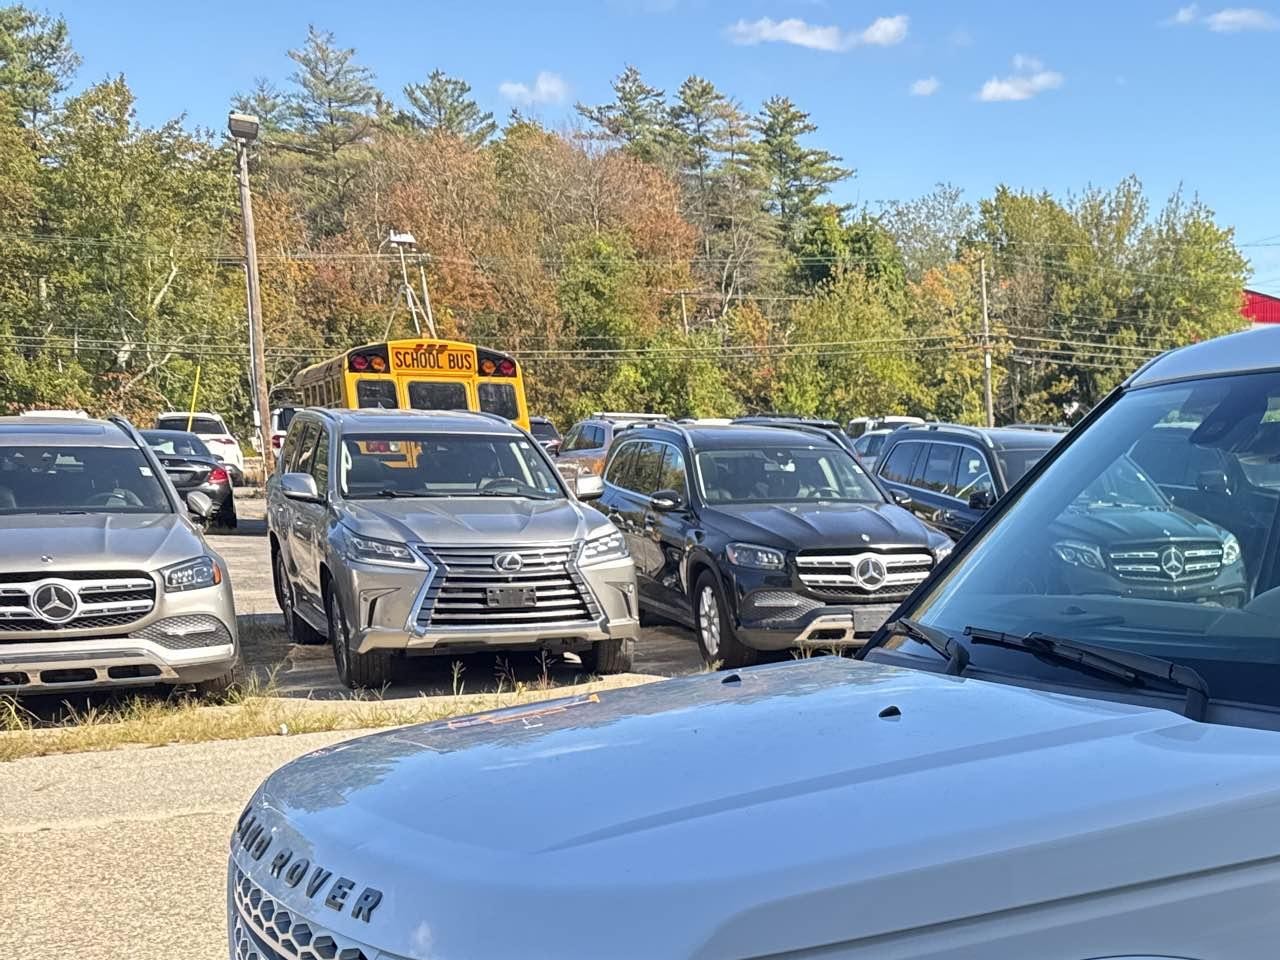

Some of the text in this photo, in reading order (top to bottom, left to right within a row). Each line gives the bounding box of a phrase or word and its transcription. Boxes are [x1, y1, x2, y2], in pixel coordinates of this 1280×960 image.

[394, 350, 473, 371] SCHOOL BUS
[269, 847, 384, 924] ROVER
